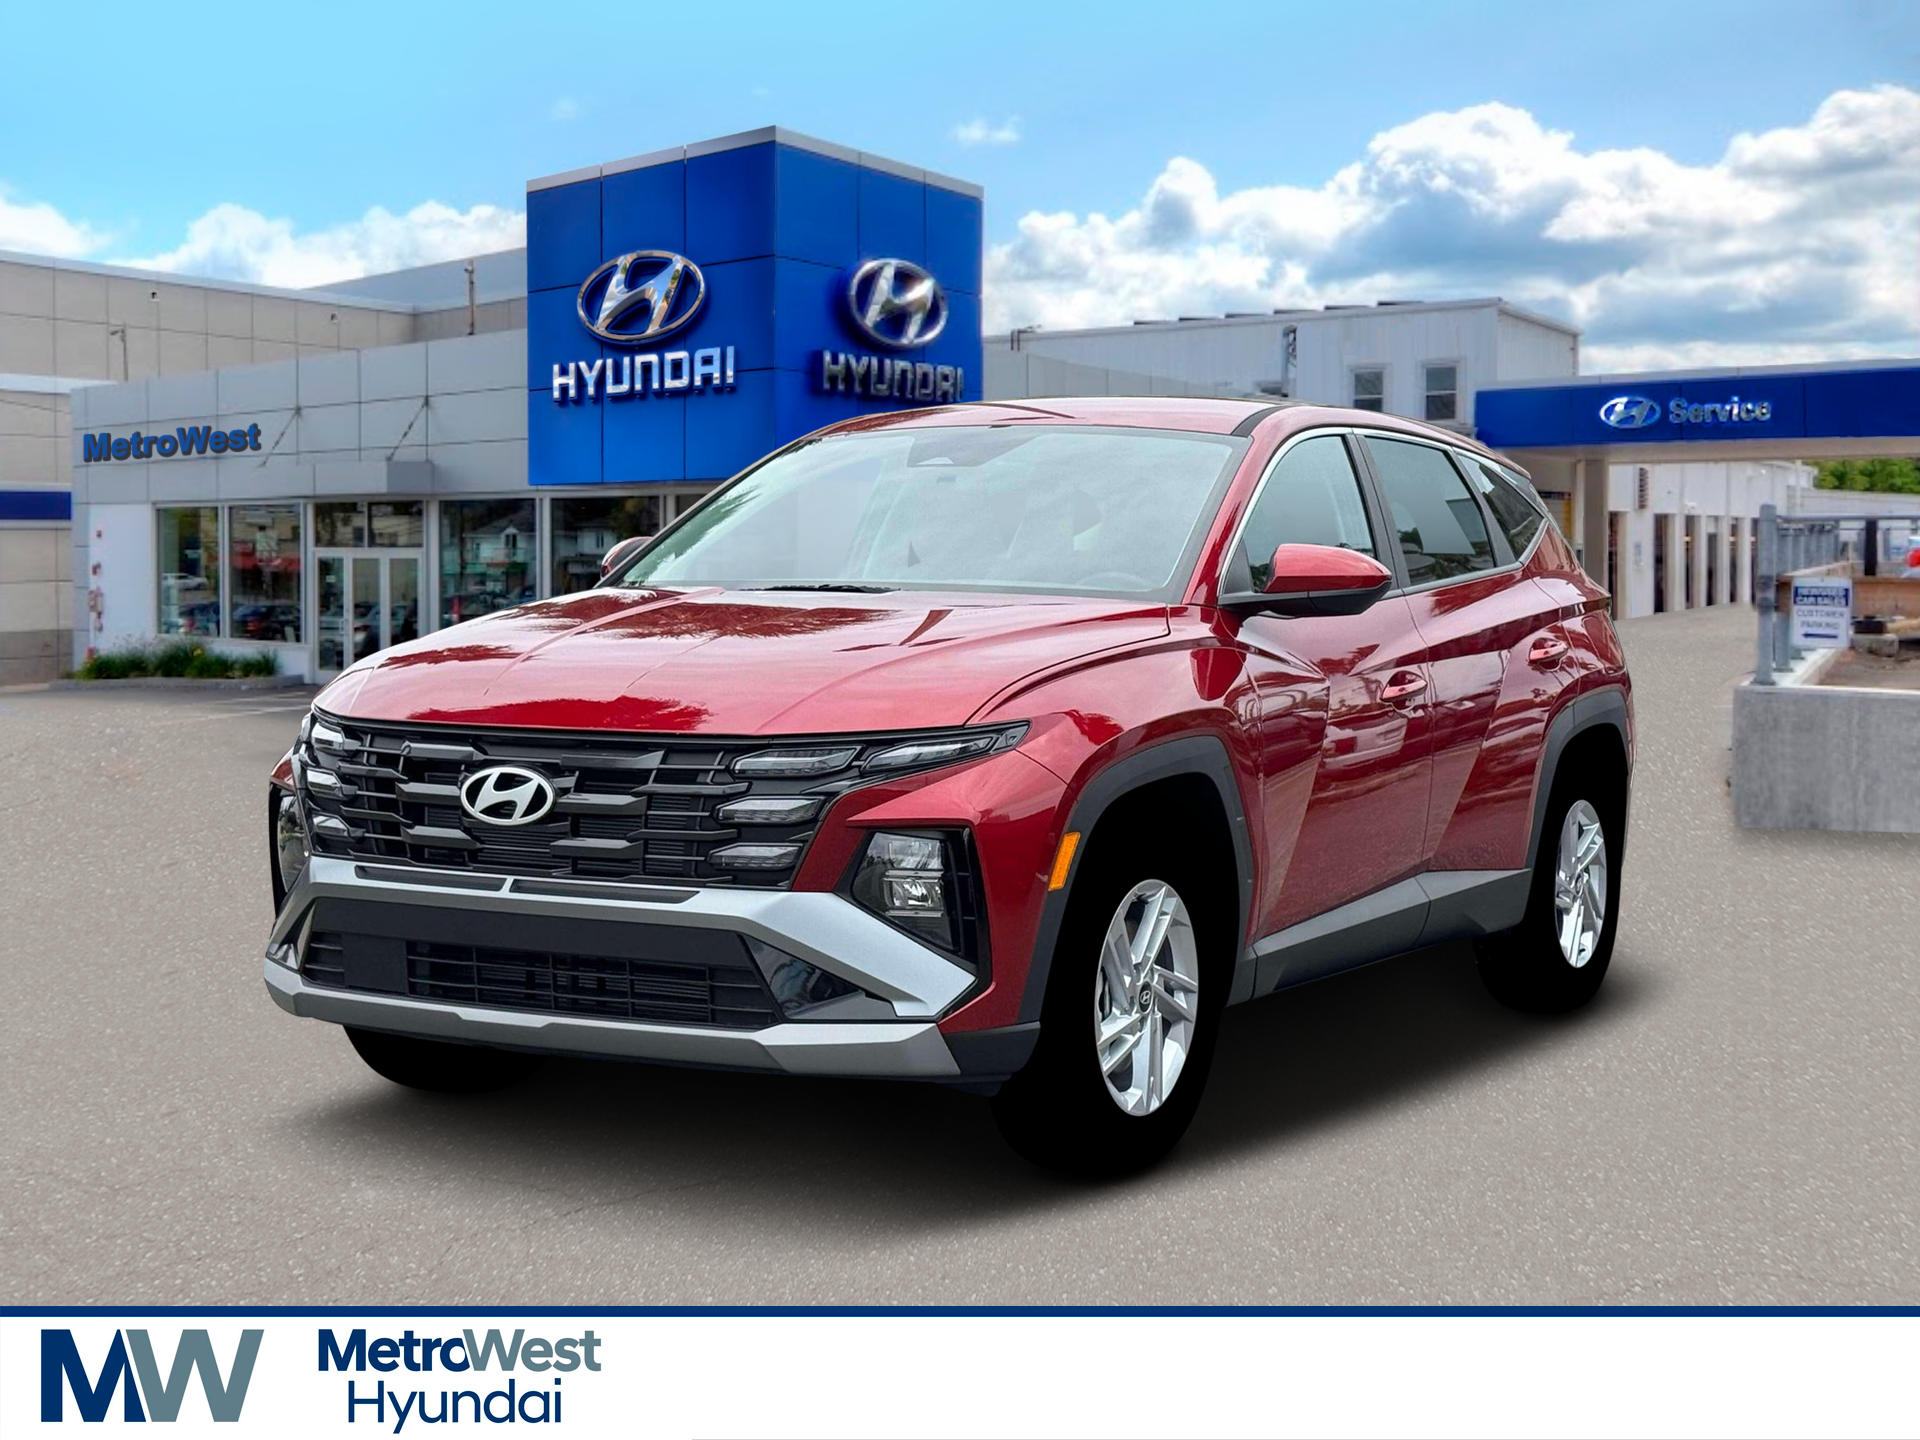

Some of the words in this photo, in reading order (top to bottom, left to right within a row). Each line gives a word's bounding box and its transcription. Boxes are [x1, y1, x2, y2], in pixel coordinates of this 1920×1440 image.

[552, 346, 736, 402] HYUNDAI
[822, 350, 964, 402] HYUNDAI
[1669, 396, 1771, 424] Service
[83, 422, 262, 463] MetroWest
